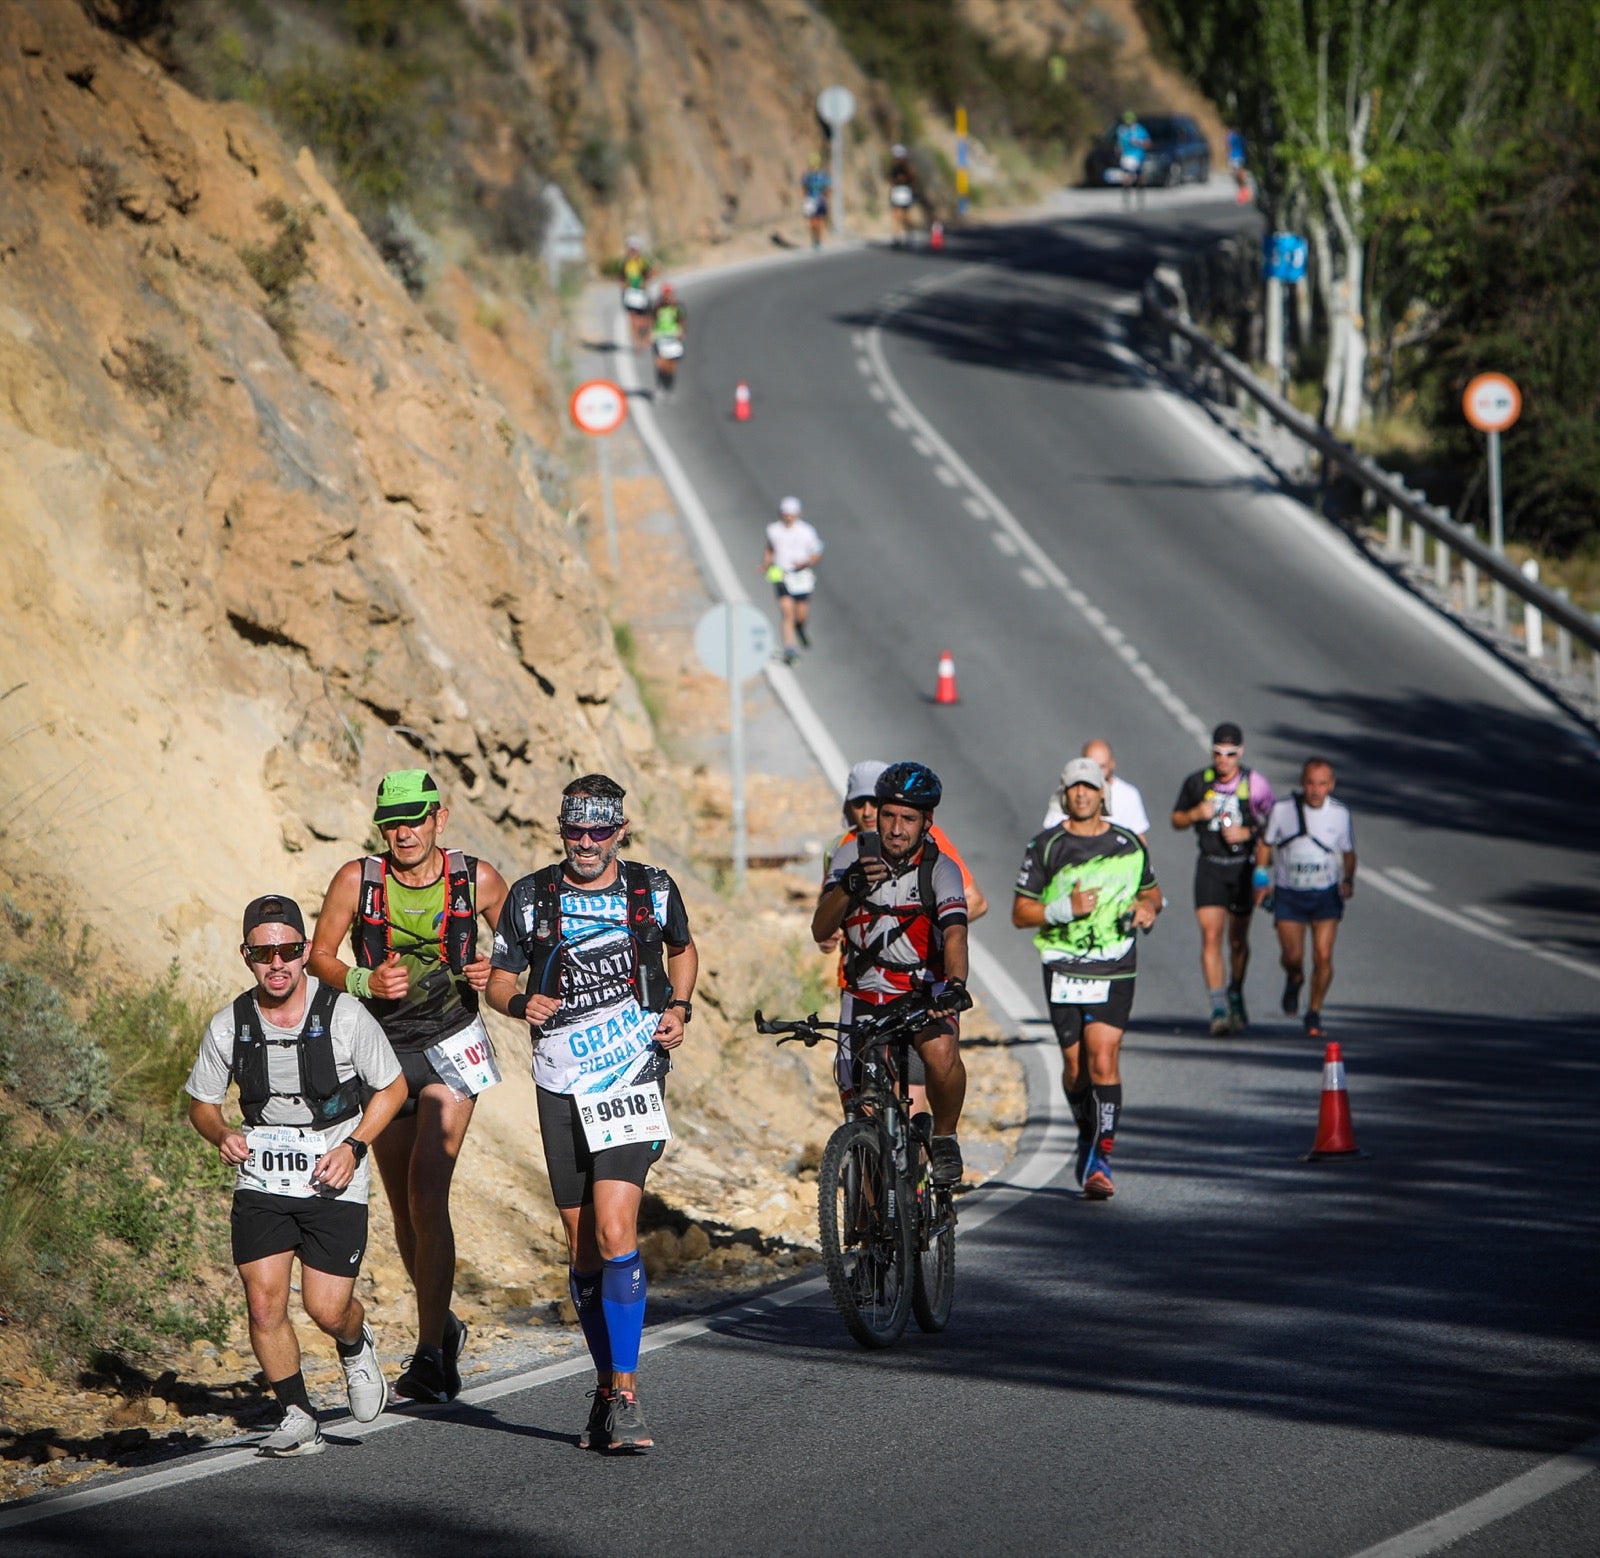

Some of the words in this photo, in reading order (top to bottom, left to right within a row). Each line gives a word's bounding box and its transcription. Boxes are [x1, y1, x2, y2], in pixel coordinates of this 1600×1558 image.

[578, 1039, 637, 1076] SIERRA
[596, 1093, 648, 1122] 9818
[261, 1150, 309, 1172] 0116
